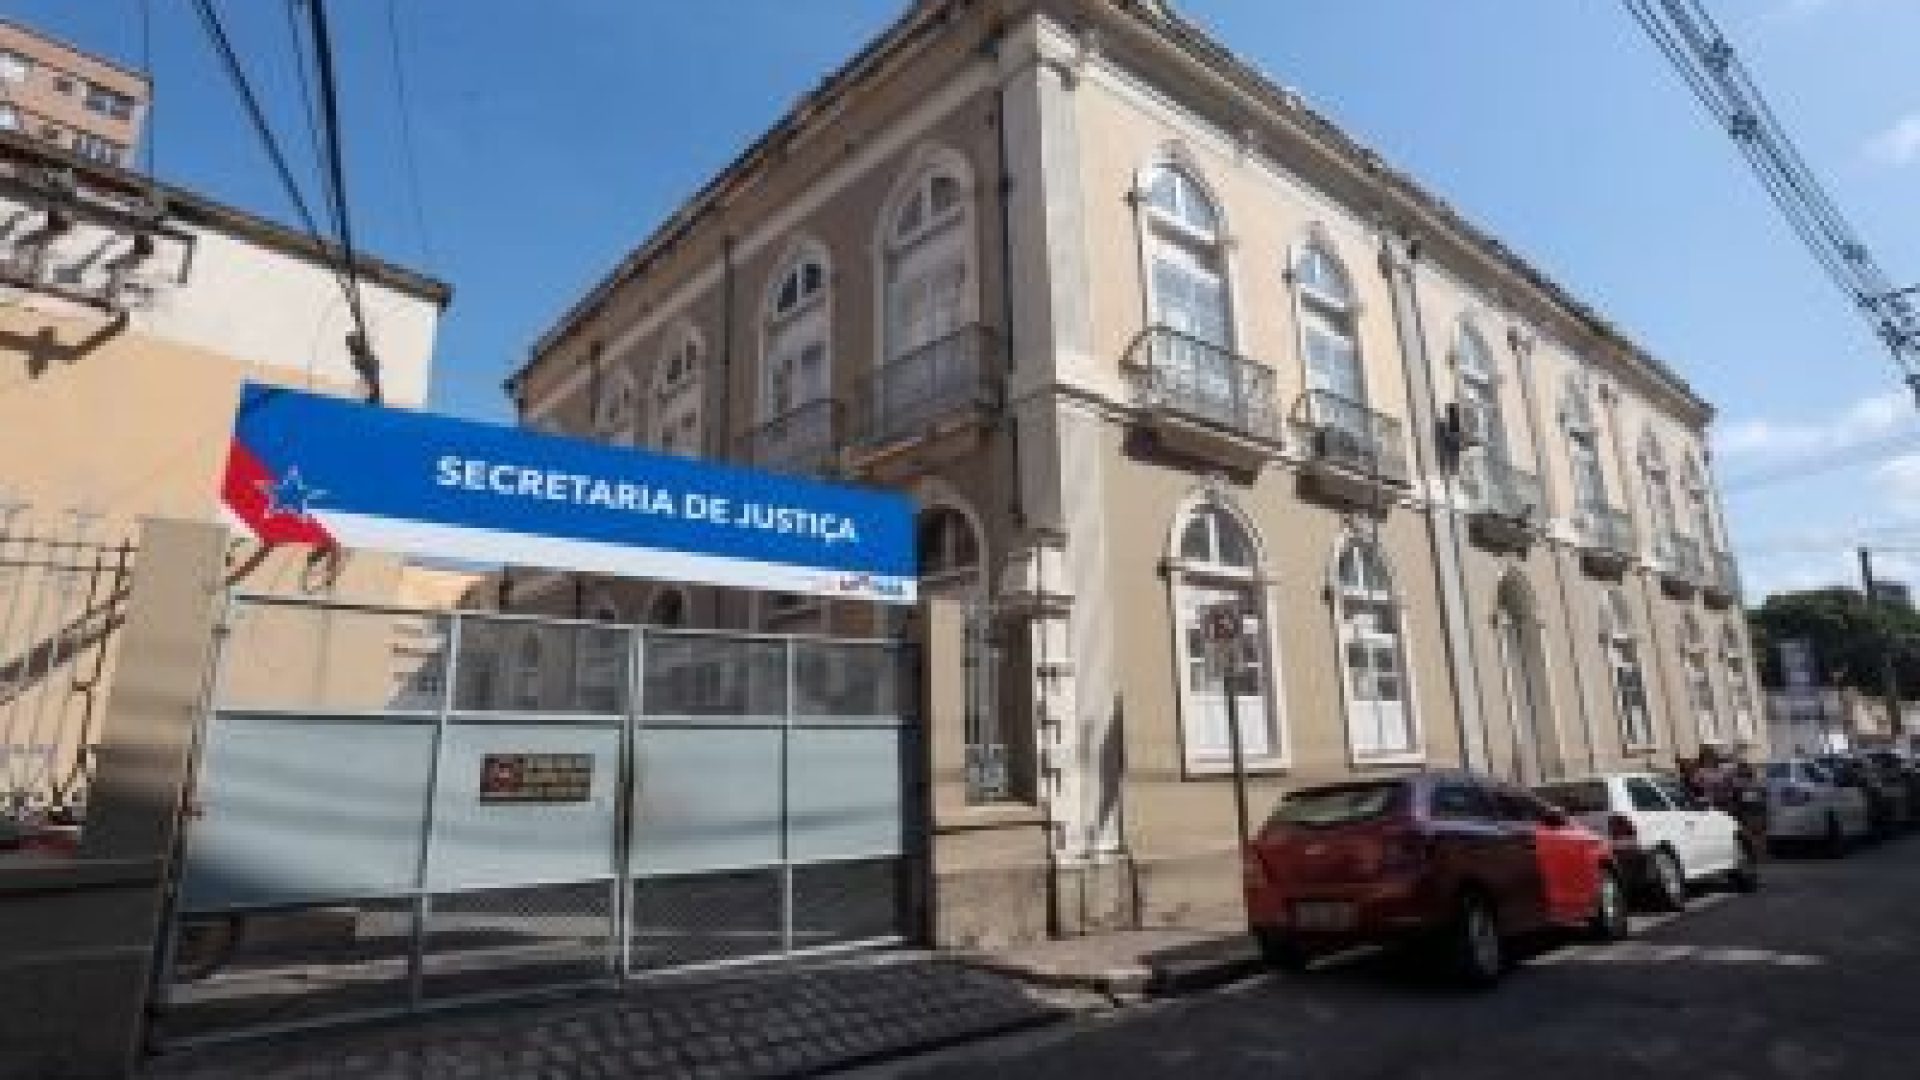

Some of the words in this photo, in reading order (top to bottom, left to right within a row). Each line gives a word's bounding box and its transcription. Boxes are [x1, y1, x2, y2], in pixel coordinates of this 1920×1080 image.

[437, 455, 674, 515] SECRETARIA
[684, 493, 731, 524] DE
[735, 502, 858, 546] JUSTIÇA
